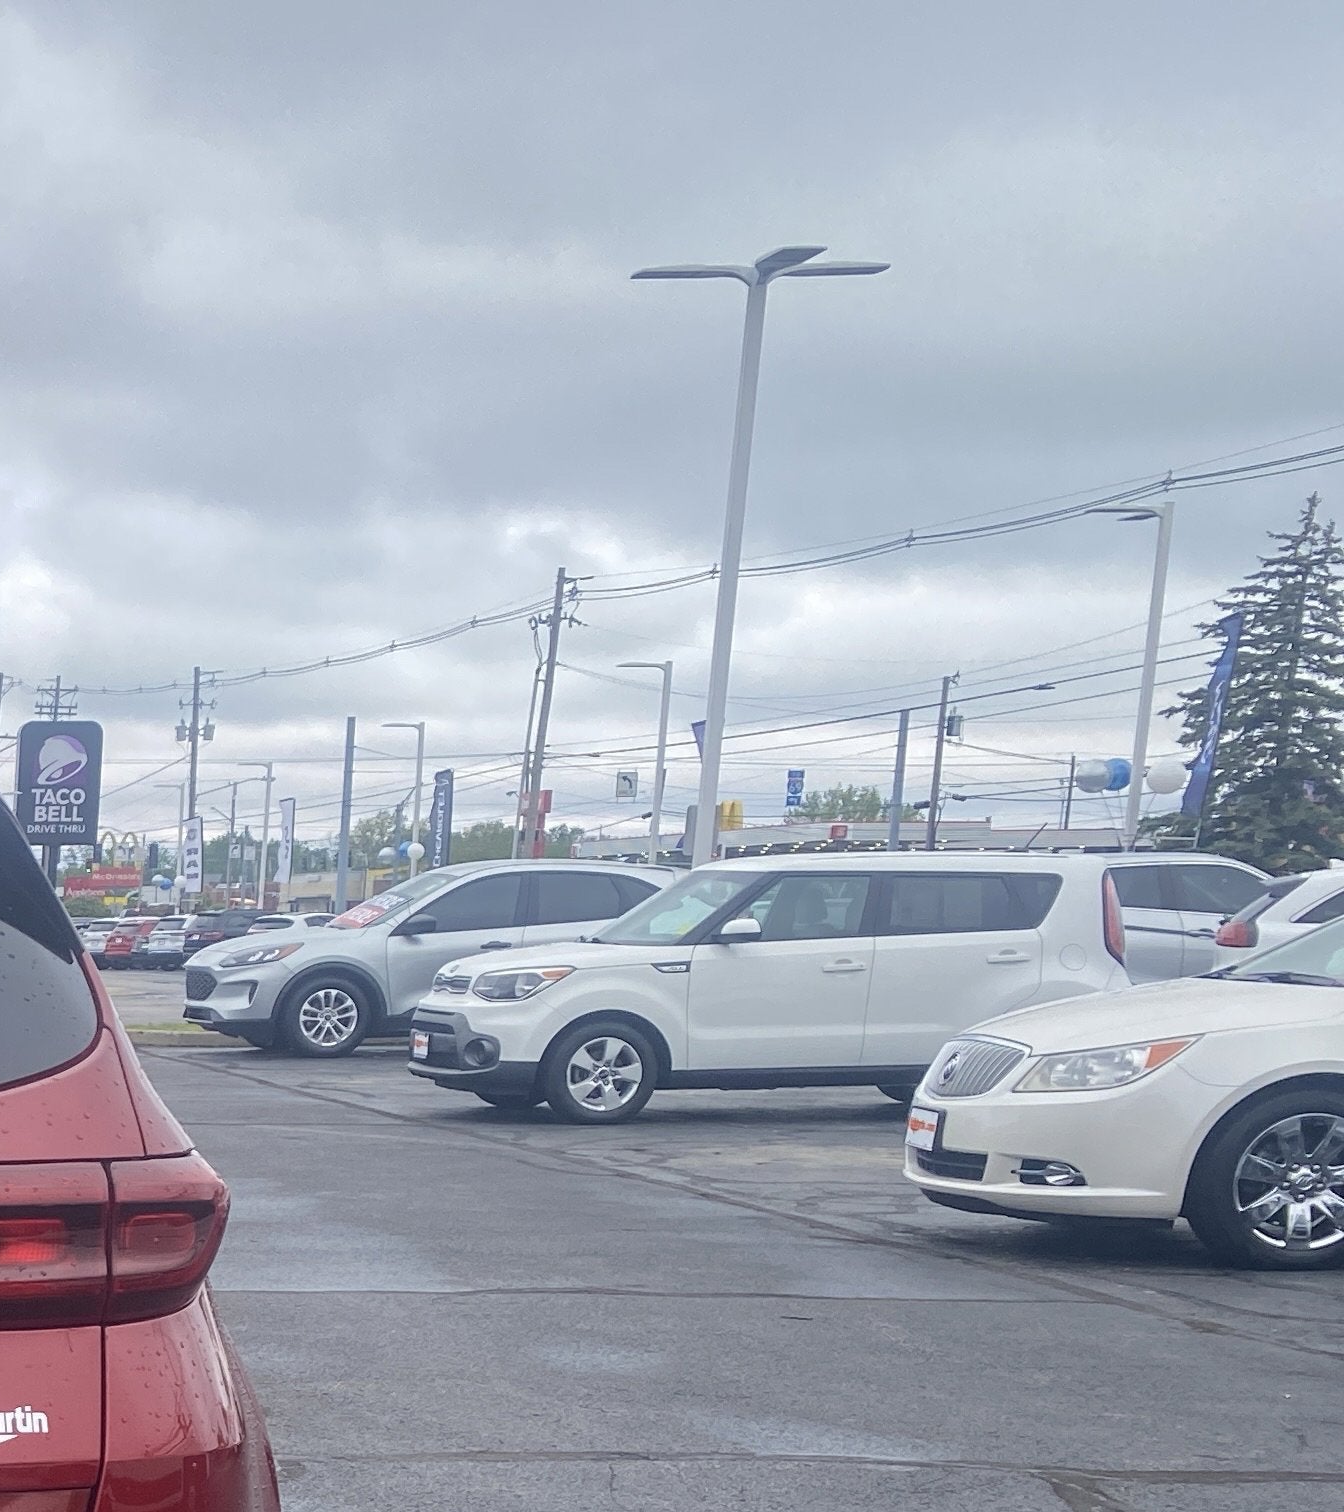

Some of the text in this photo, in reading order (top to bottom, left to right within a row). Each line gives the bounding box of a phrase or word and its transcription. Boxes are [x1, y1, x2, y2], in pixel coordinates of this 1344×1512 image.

[31, 788, 86, 805] TACO
[34, 805, 84, 822] BELL
[26, 824, 86, 834] DRIVE THRU
